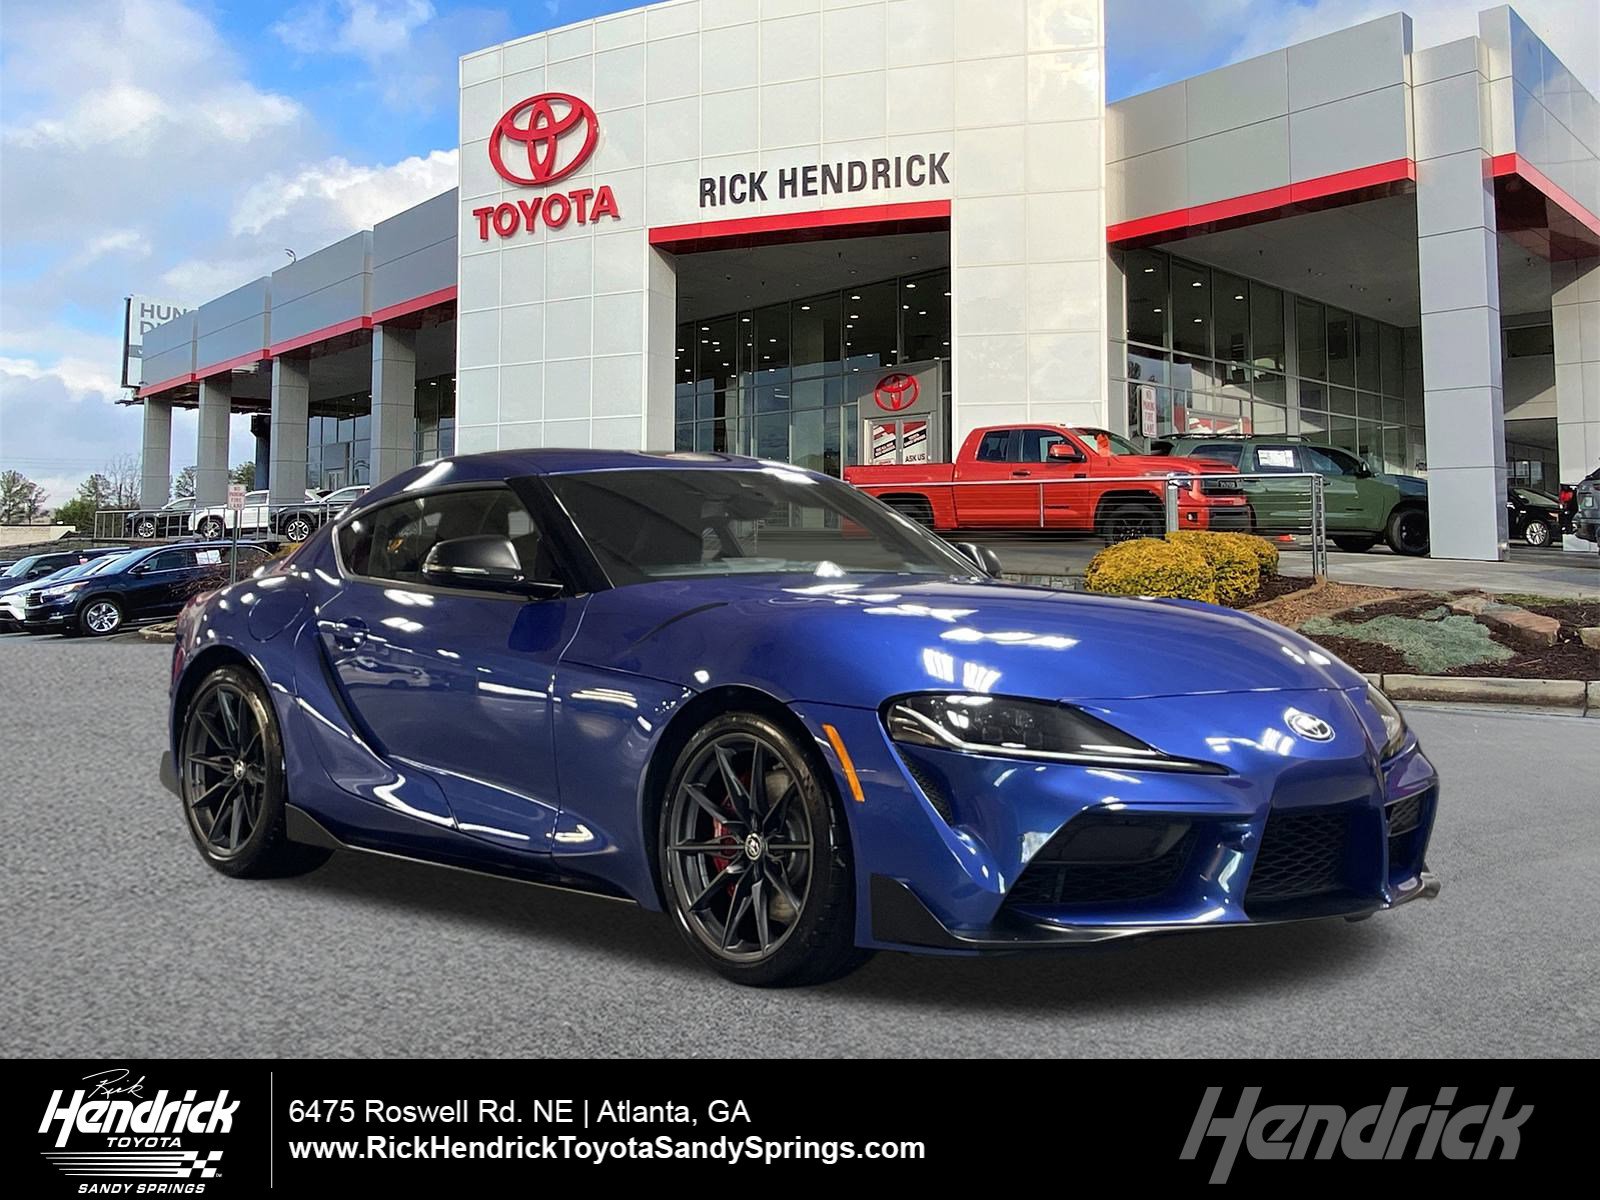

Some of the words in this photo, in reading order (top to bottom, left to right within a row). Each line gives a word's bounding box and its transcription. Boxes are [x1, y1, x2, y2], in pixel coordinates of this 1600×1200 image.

[699, 171, 768, 208] RICK
[779, 152, 951, 200] HENDRICK
[473, 185, 620, 241] TOYOTA
